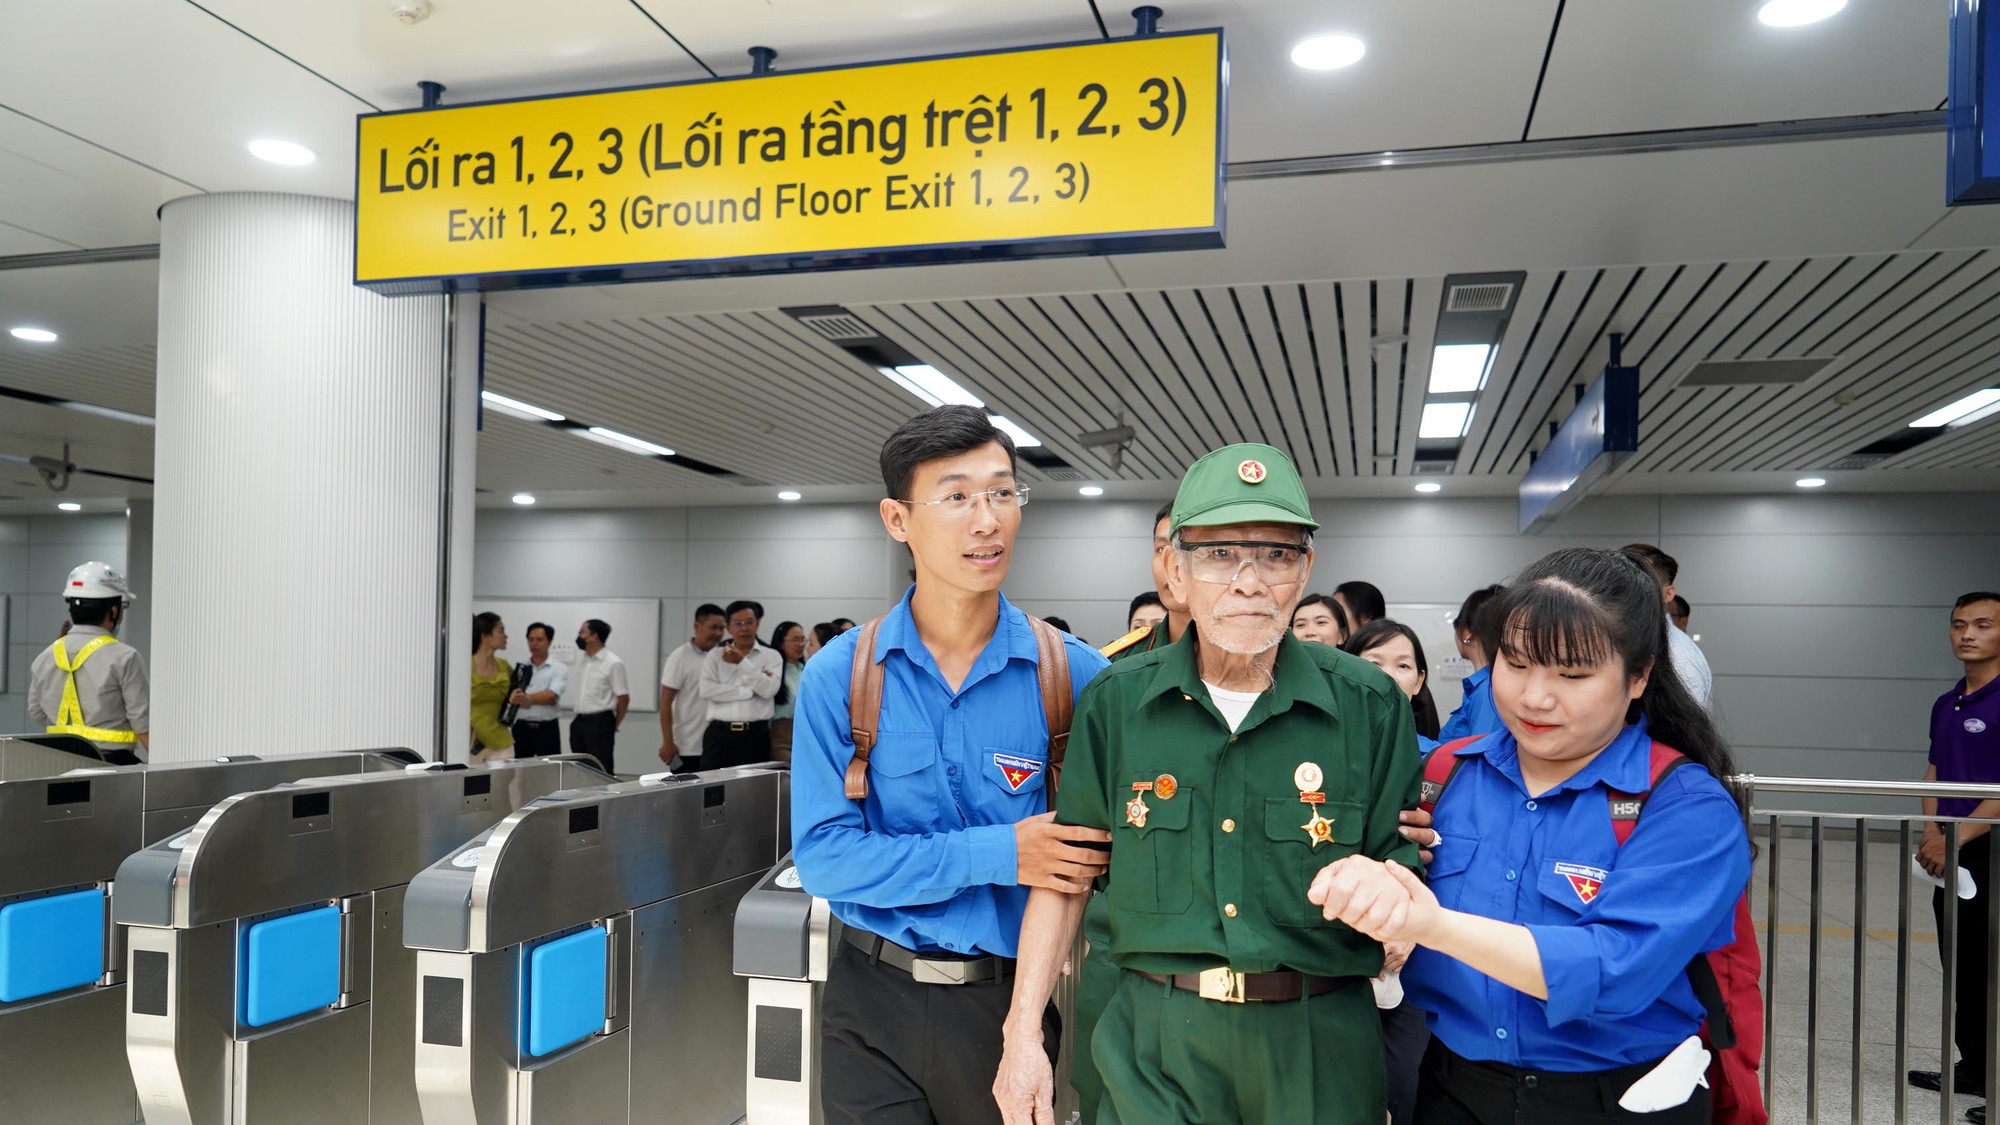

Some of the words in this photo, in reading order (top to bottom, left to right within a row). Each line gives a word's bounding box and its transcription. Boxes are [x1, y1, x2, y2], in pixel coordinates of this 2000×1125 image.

[380, 138, 440, 193] Lối
[453, 152, 496, 187] ra
[511, 136, 535, 185] 1,
[549, 132, 583, 181] 2,
[598, 128, 624, 176] 3
[639, 118, 723, 179] (Lối
[738, 127, 787, 165] ra
[800, 100, 908, 165] tầng
[924, 93, 1012, 158] trệt
[1030, 88, 1060, 143] 1,
[1077, 83, 1121, 138] 2,
[1138, 77, 1187, 137] 3)
[449, 207, 506, 242] Exit
[519, 205, 537, 239] 1,
[550, 202, 577, 237] 2,
[589, 199, 607, 233] 3
[620, 187, 762, 235] (Ground
[776, 183, 872, 219] Floor
[886, 173, 956, 211] Exit
[971, 169, 993, 207] 1,
[1009, 167, 1040, 203] 2,
[1056, 162, 1090, 203] 3)
